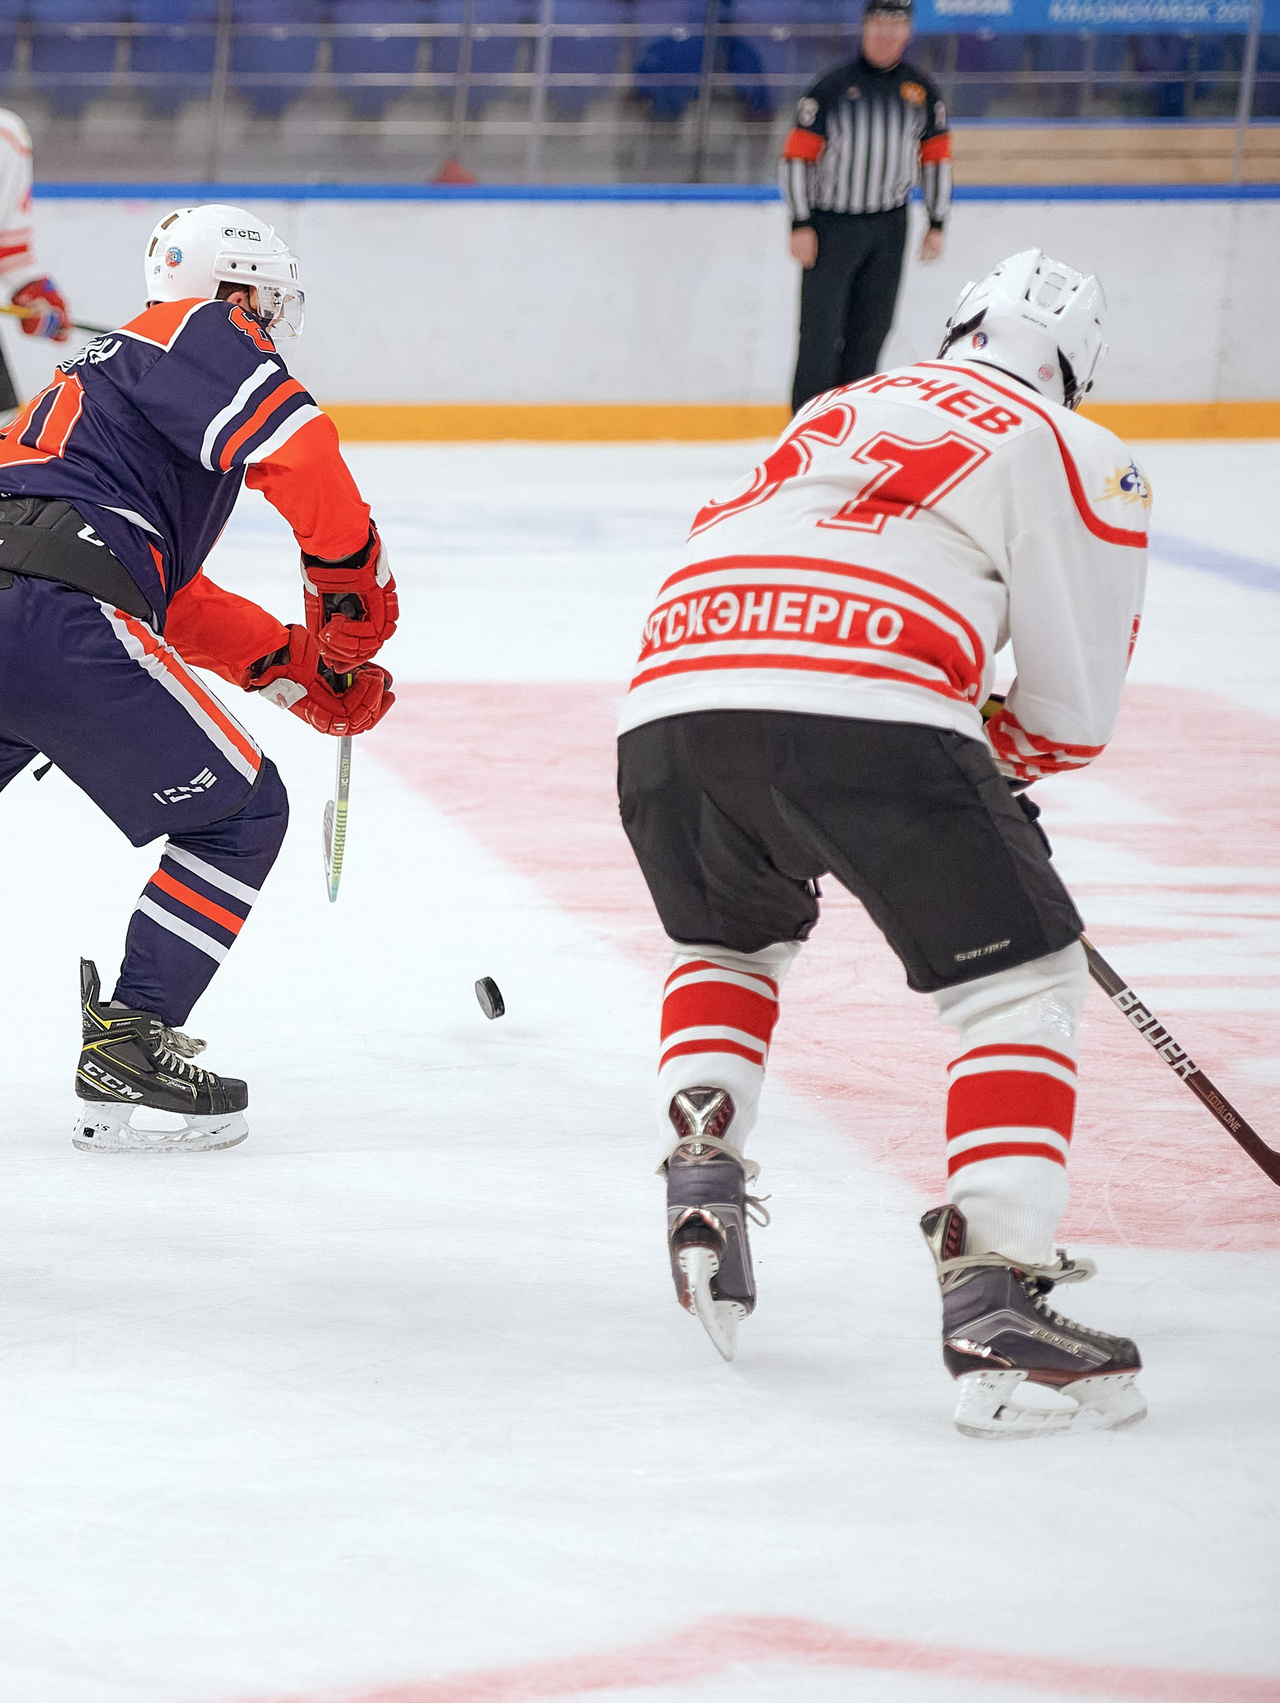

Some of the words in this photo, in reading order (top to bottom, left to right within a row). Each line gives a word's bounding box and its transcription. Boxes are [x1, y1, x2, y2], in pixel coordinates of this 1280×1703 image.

[223, 228, 261, 241] CCM
[1111, 986, 1199, 1081] BAUER
[83, 1060, 144, 1100] CCM
